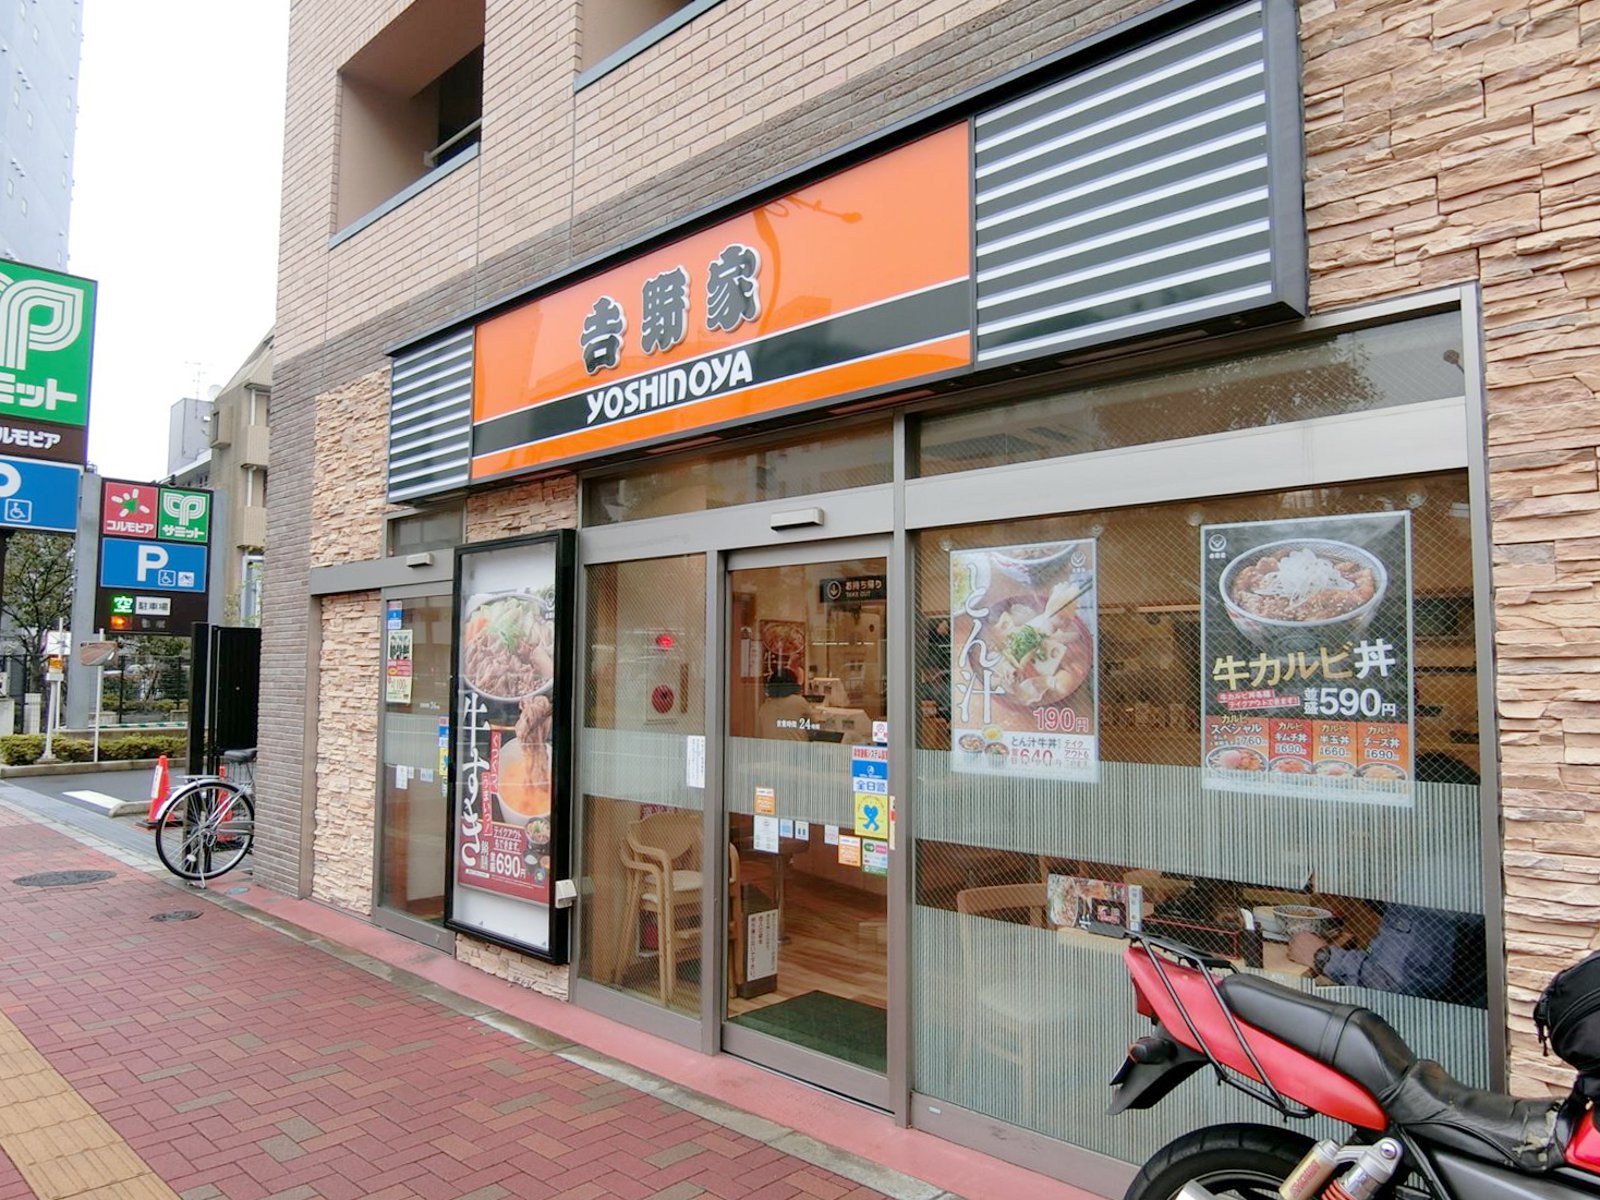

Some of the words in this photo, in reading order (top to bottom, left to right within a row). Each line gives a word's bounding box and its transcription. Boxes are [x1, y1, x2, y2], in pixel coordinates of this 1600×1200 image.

[587, 350, 752, 424] YOSHINOYA
[106, 520, 154, 534] コルモピア
[162, 525, 205, 539] サミット
[137, 544, 169, 582] P
[113, 596, 133, 613] 空
[138, 601, 169, 611] 駐車場
[956, 563, 1005, 724] とん汁
[1212, 638, 1396, 690] 牛カルビ丼
[1033, 706, 1089, 733] 190円
[1211, 723, 1262, 735] スペシャル
